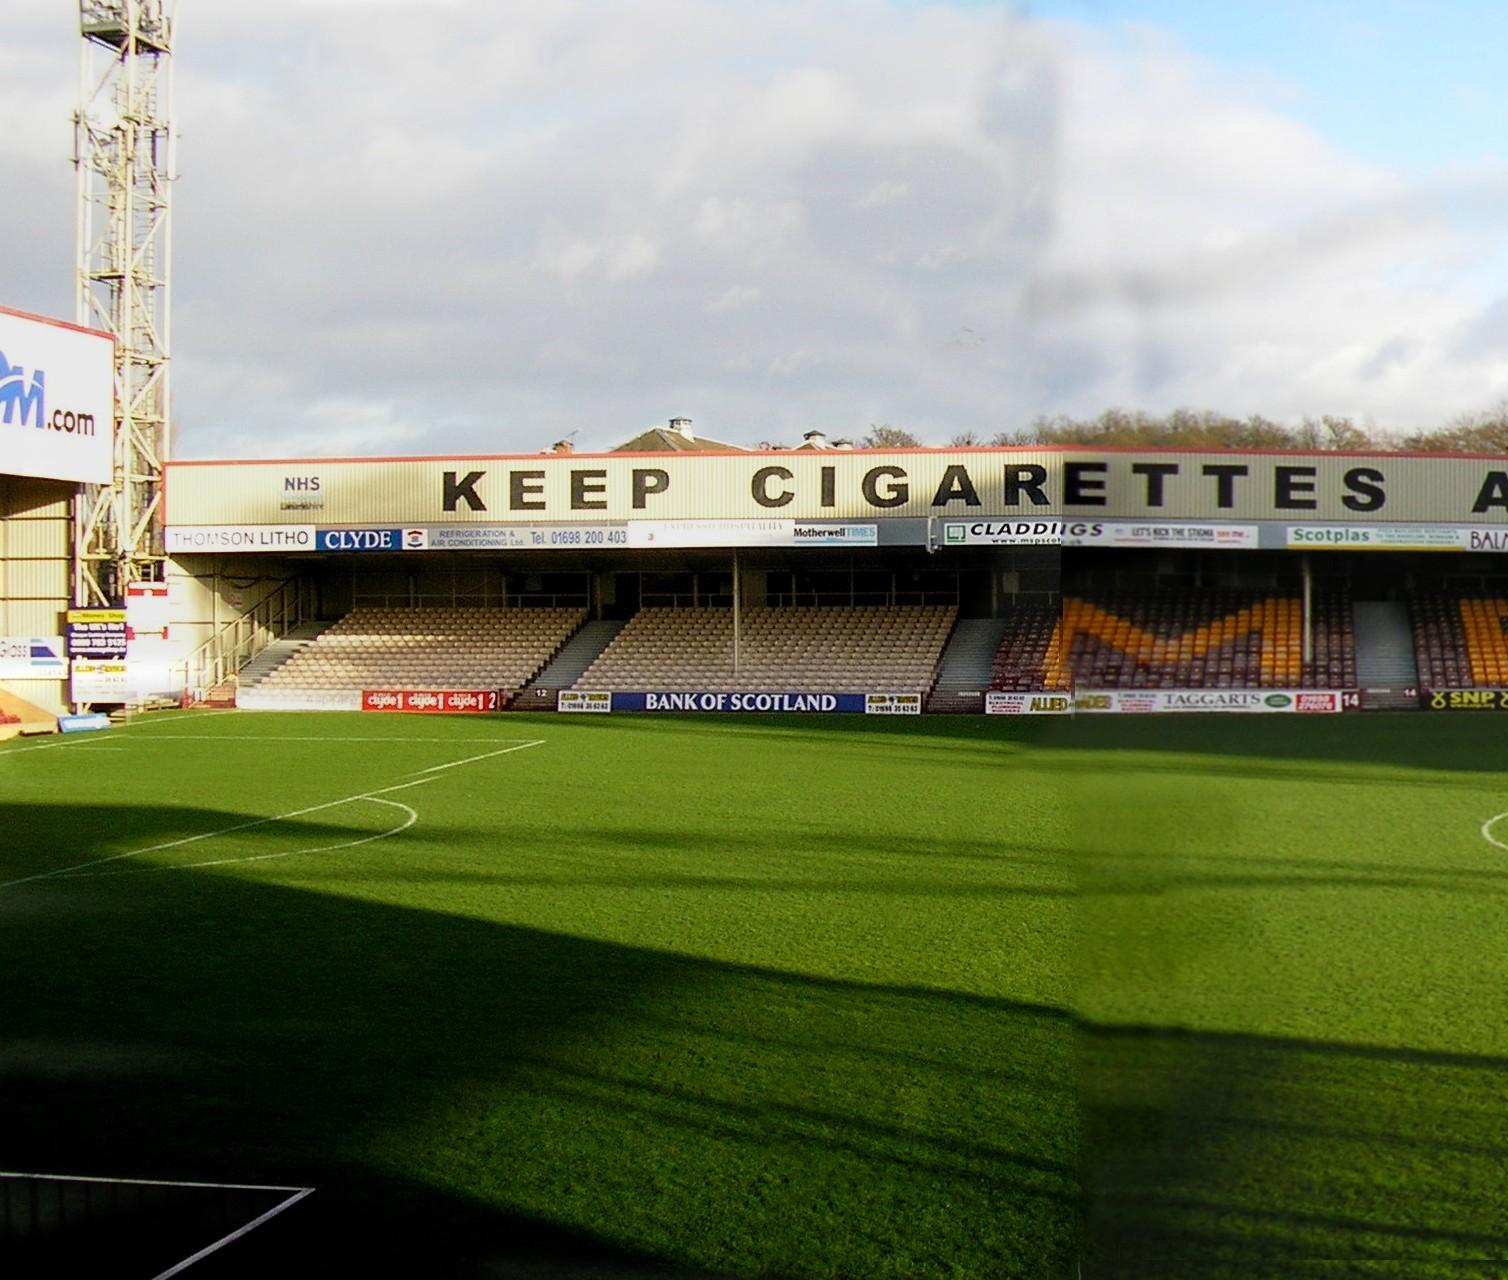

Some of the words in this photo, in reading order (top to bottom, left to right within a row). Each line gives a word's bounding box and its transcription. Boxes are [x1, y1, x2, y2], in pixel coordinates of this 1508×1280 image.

[284, 476, 321, 491] NHS
[443, 468, 669, 512] KEEP
[751, 462, 1385, 511] CIGARETTES
[174, 532, 254, 547] THOMSON
[261, 531, 309, 545] LITHO
[439, 530, 506, 538] REFRIGERATION
[509, 530, 515, 538] &
[551, 531, 580, 545] 01698
[585, 531, 604, 544] 200
[608, 530, 627, 544] 403
[793, 526, 846, 538] Motherwell
[846, 527, 876, 538] TIMES
[1172, 528, 1185, 538] THE
[1293, 528, 1370, 544] Scotplas
[325, 531, 392, 549] CLYDE
[448, 539, 508, 547] CONDITIONING
[488, 693, 496, 709] 2
[645, 693, 698, 710] BANK
[700, 693, 727, 710] OF
[730, 693, 837, 711] SCOTLAND
[1165, 693, 1261, 705] TAGGARTS
[1342, 694, 1359, 707] 14
[1451, 691, 1496, 704] SNP
